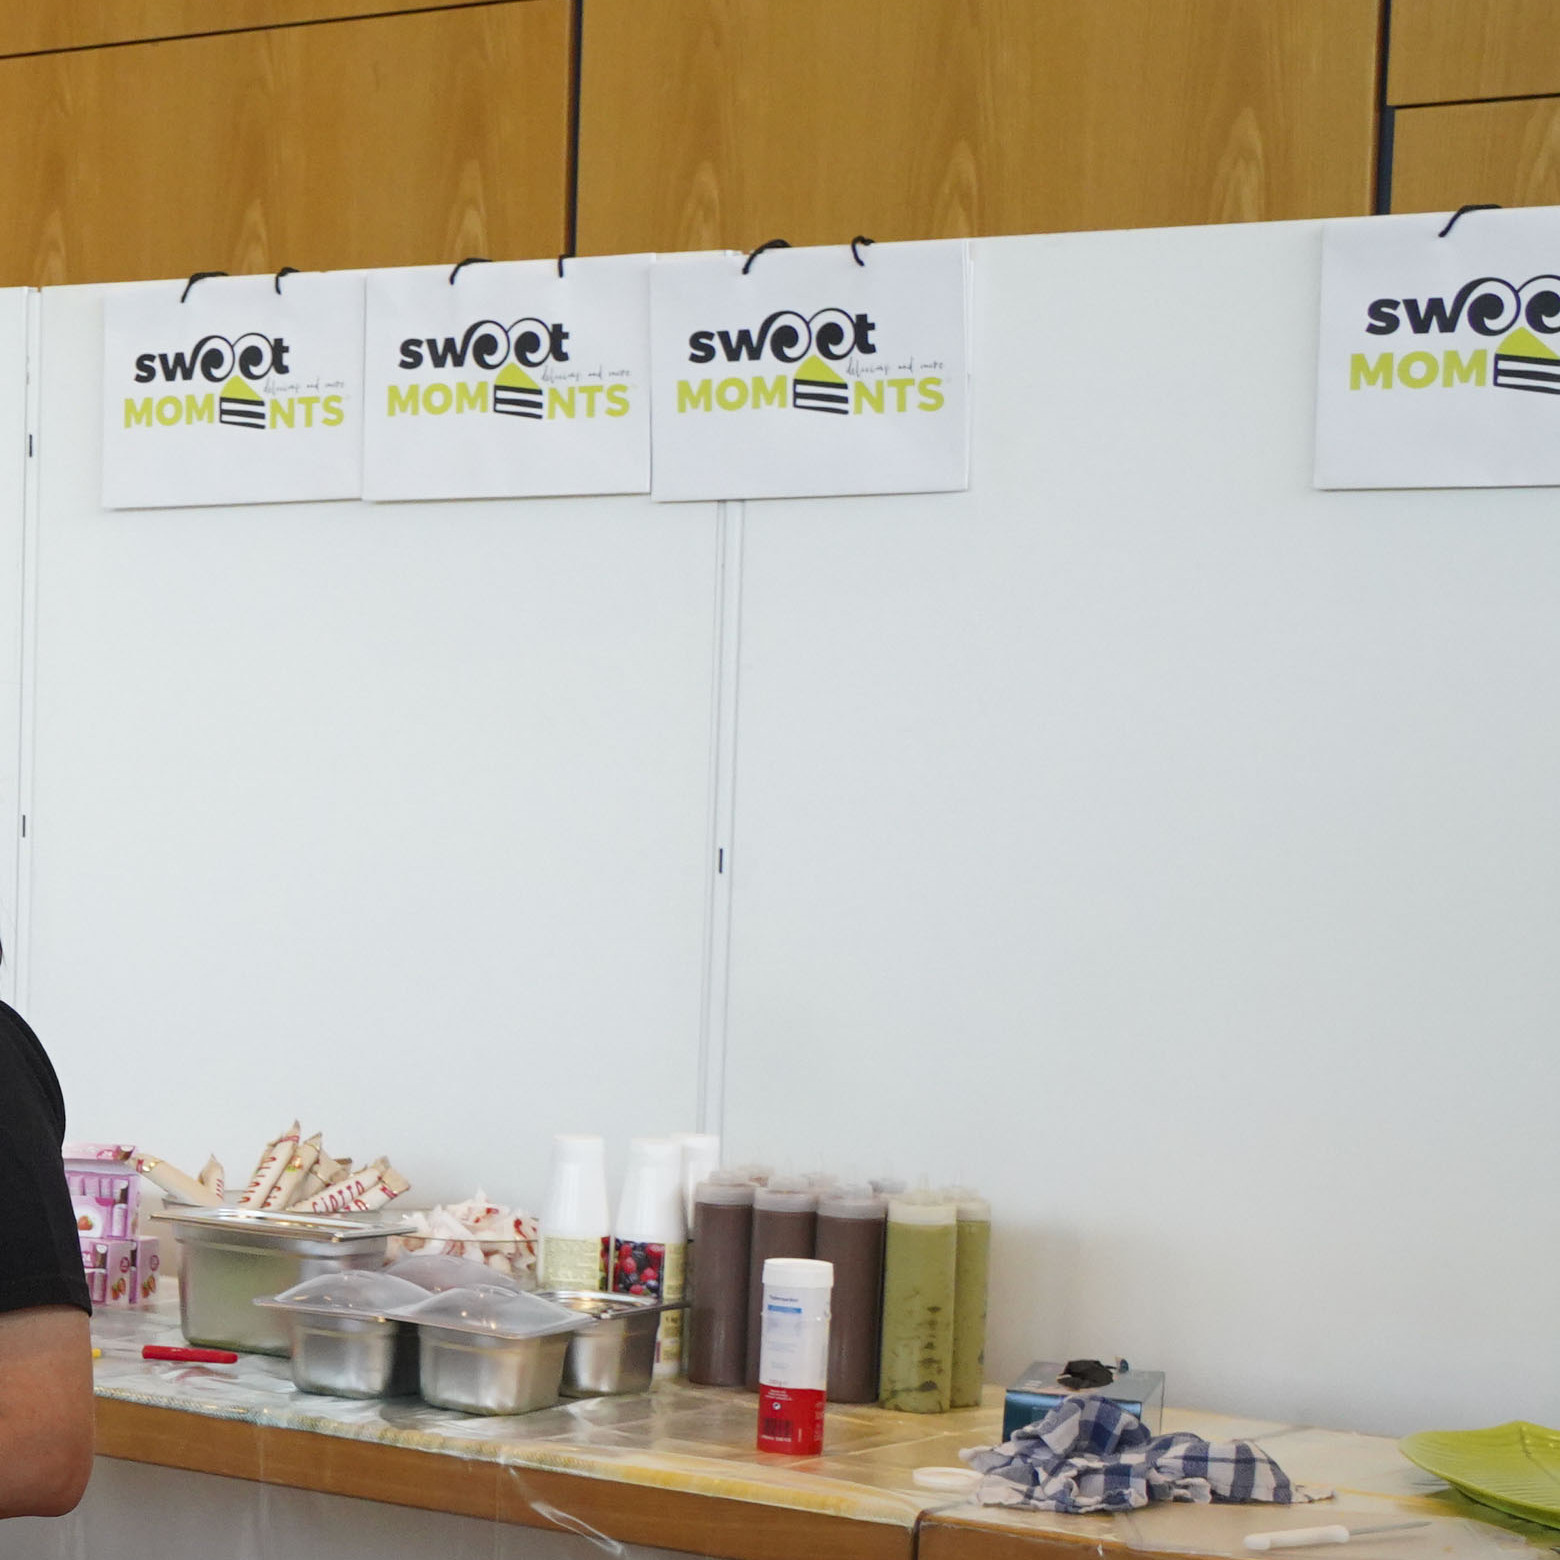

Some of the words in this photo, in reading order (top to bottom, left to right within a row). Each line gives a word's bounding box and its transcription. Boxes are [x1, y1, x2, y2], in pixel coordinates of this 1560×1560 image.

[1366, 274, 1560, 336] swee
[134, 332, 290, 383] sweet
[398, 317, 569, 370] sweet
[688, 307, 876, 363] sweet
[1350, 326, 1560, 395] MOME
[124, 377, 344, 430] MOMENTS
[387, 364, 630, 420] MOMENTS
[677, 356, 945, 415] MOMENTS
